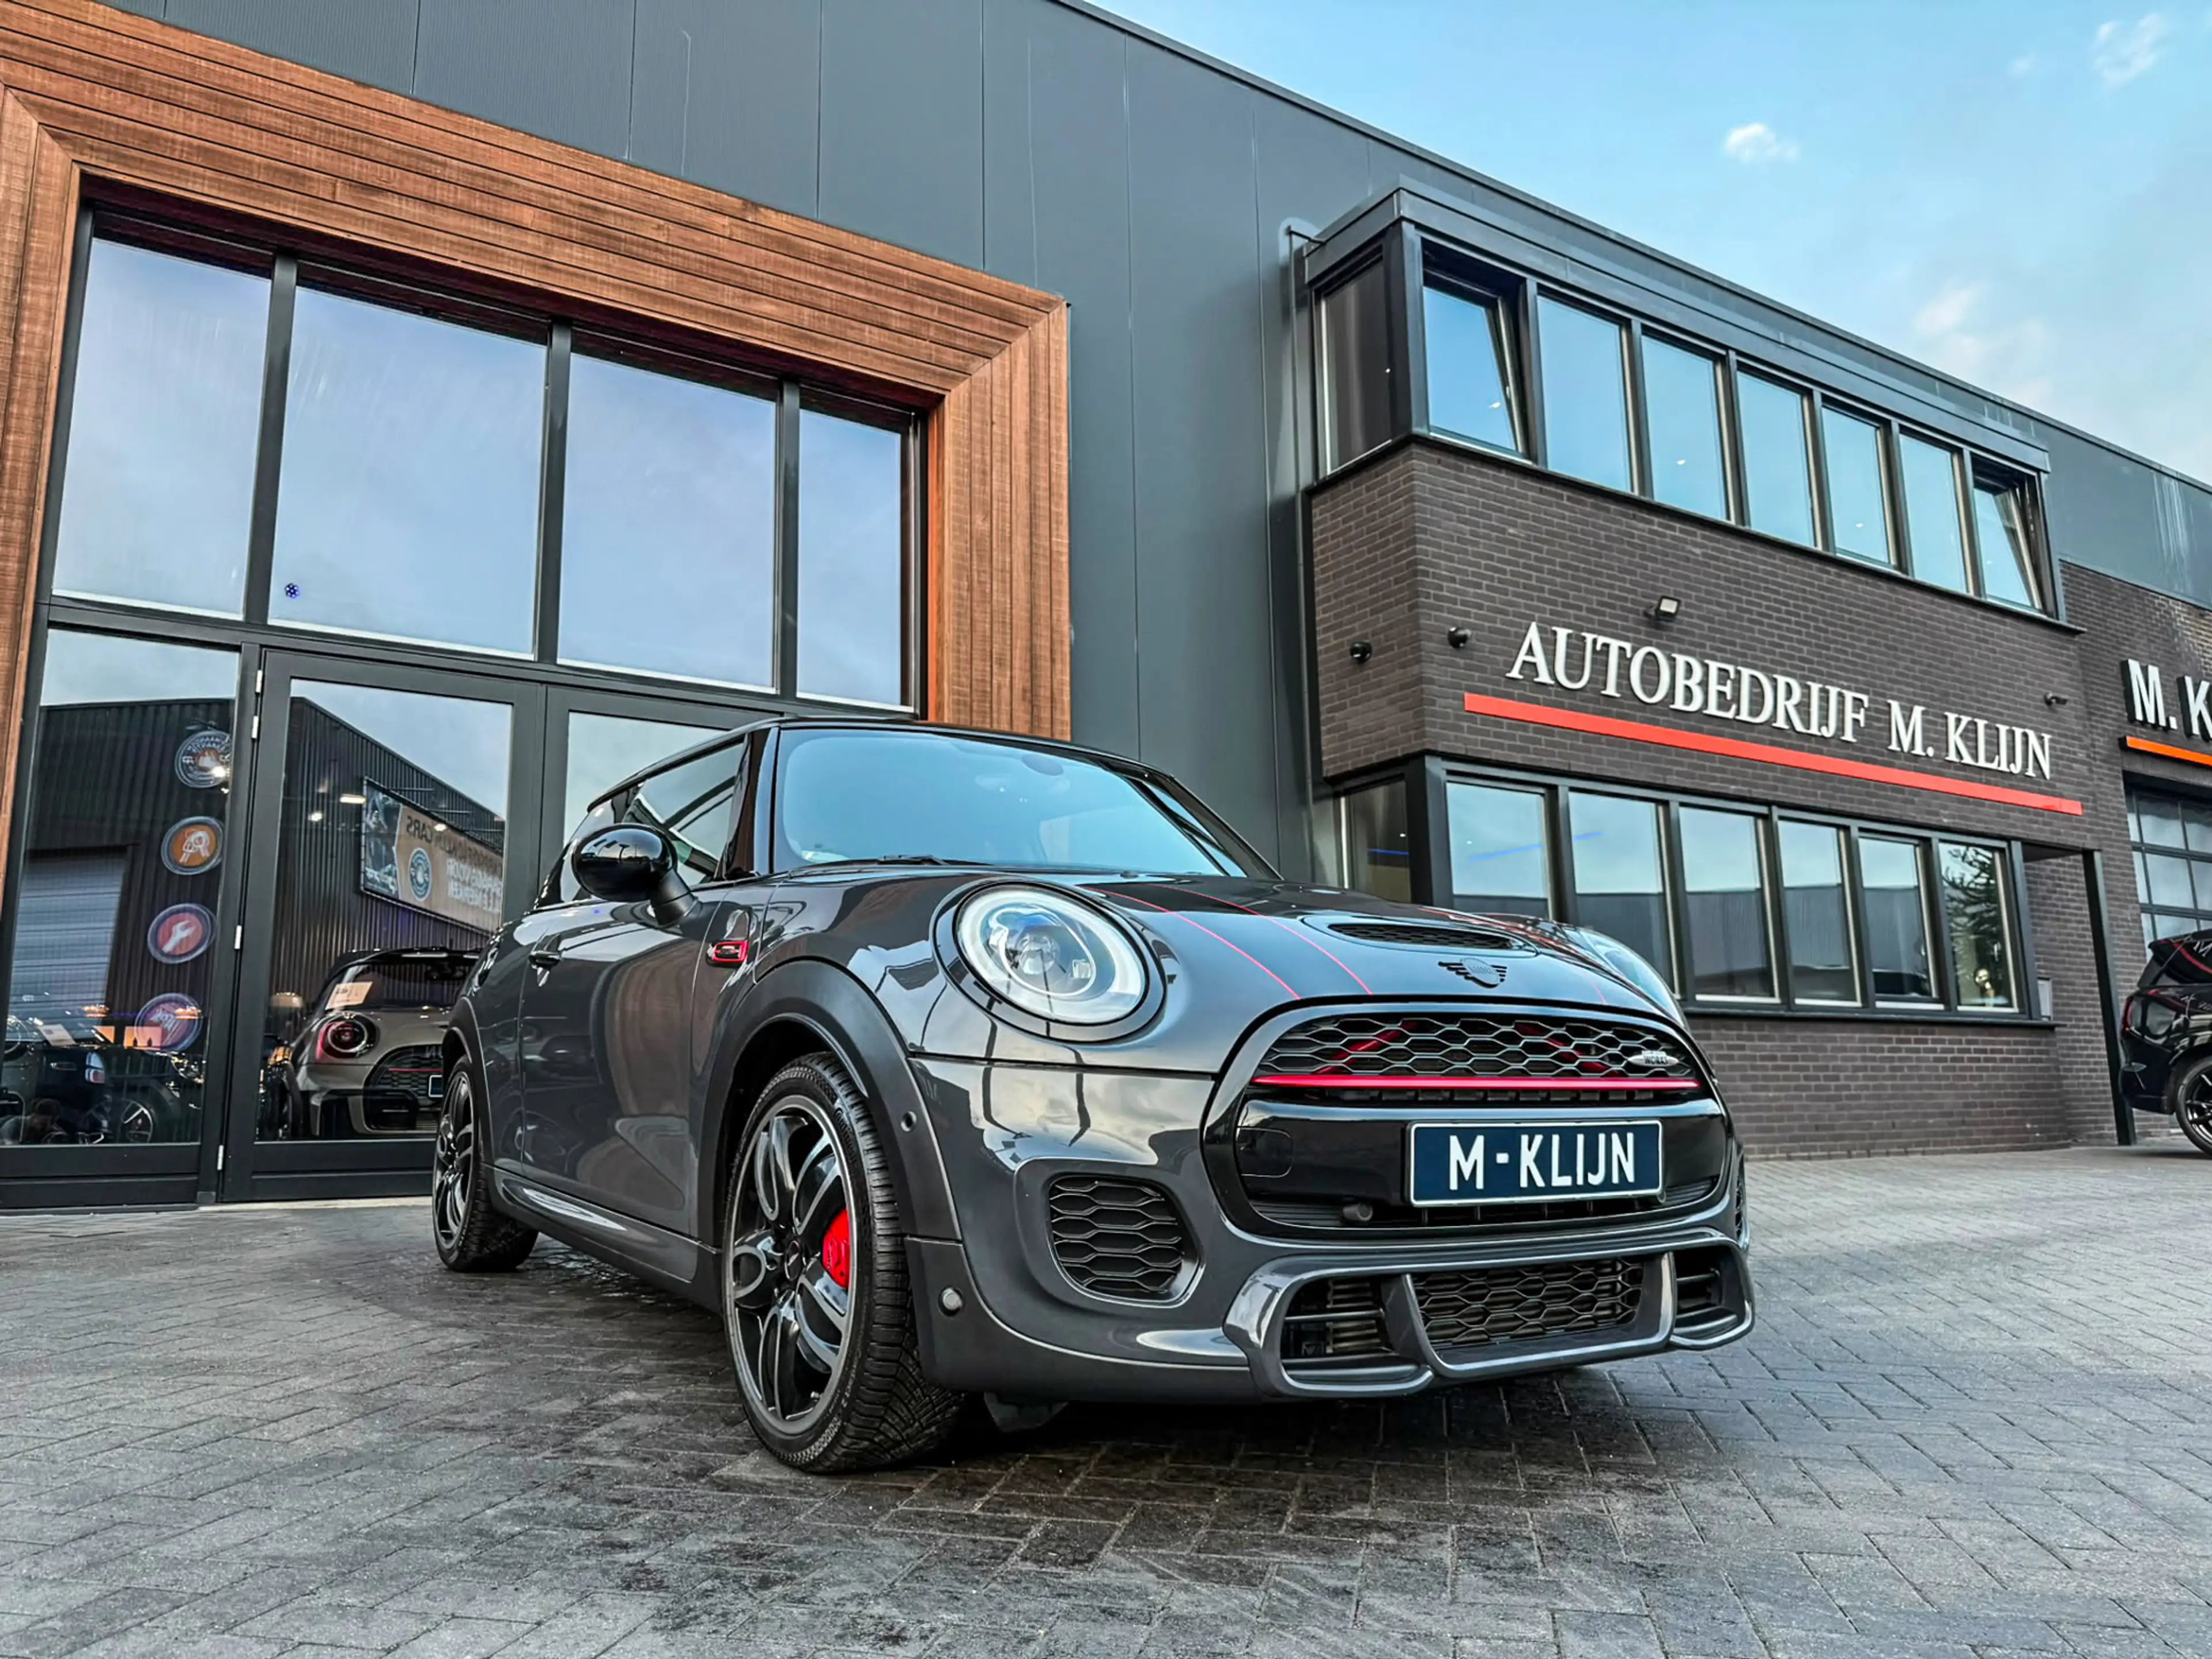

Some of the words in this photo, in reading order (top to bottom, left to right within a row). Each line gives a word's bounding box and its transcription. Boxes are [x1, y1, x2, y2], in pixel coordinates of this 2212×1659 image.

[1506, 621, 1869, 743] AUTOBEDRIJF
[1887, 699, 1934, 757] M.
[1944, 711, 2052, 780] KLIJN
[2127, 658, 2179, 730] M.
